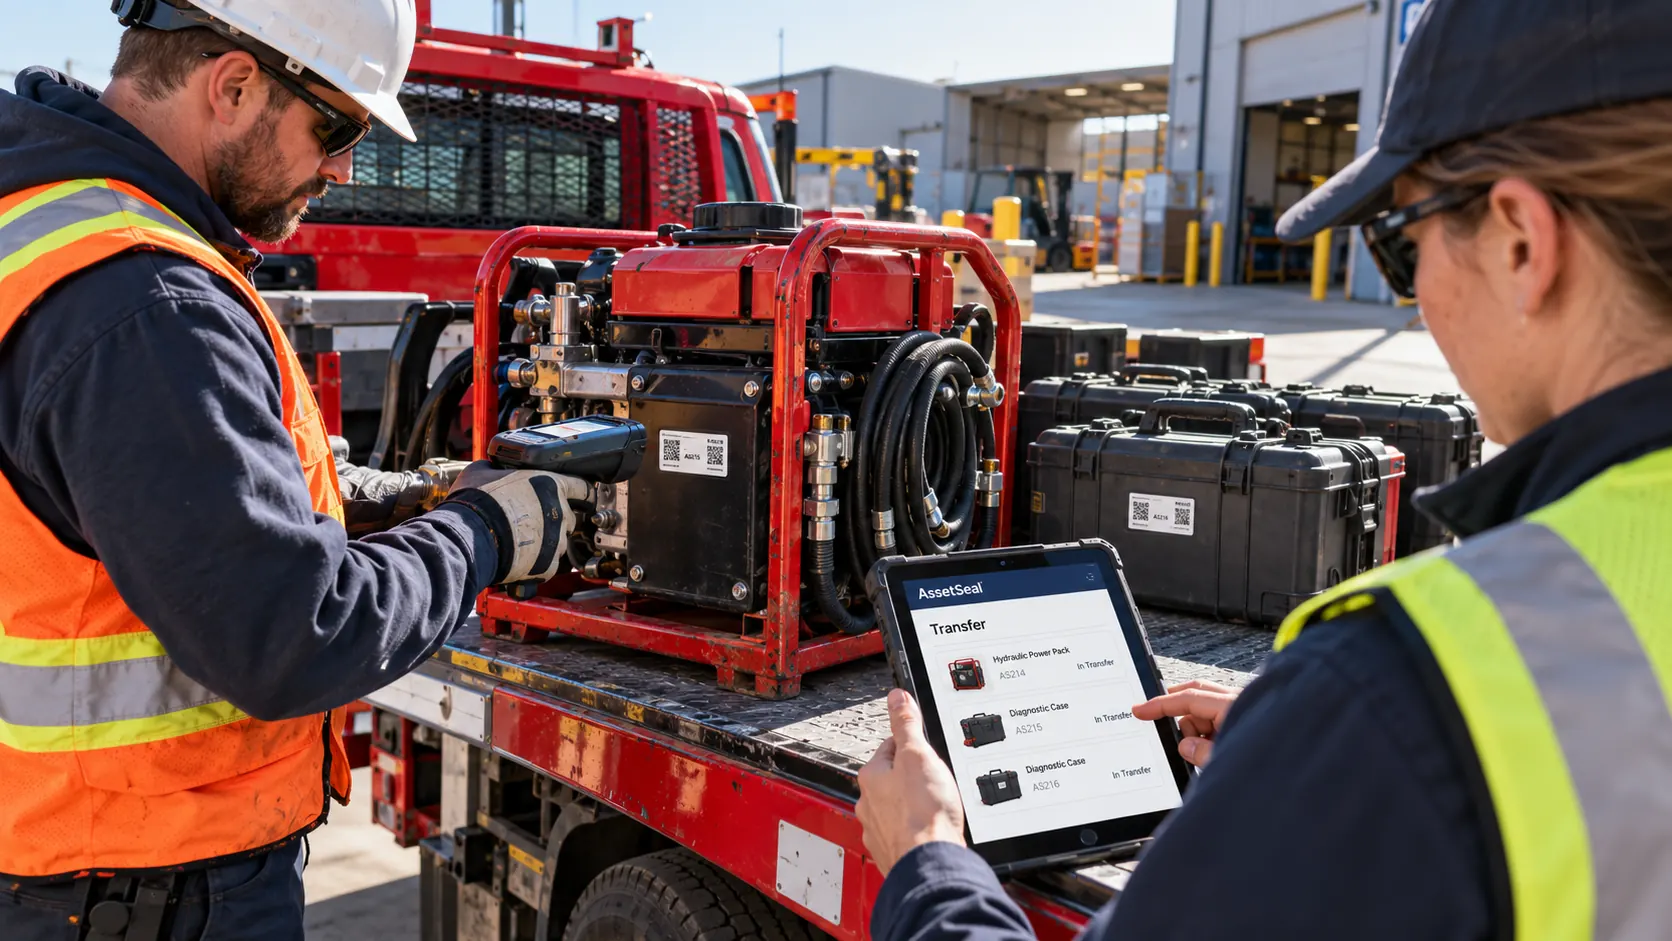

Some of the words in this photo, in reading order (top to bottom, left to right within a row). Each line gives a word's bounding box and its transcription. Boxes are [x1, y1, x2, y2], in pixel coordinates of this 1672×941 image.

[918, 581, 983, 600] AssetSeal
[929, 619, 986, 635] Transfer
[993, 651, 1029, 664] Hydraulic
[1029, 649, 1051, 659] Power
[1052, 646, 1070, 655] Pack
[1085, 658, 1114, 669] Transfer
[1000, 669, 1026, 680] AS214
[1009, 705, 1049, 718] Diagnostic
[1050, 702, 1069, 711] Case
[1094, 716, 1102, 724] In
[1102, 711, 1133, 722] Transfer
[1016, 723, 1043, 735] AS215
[1026, 760, 1066, 774] Diagnostic
[1067, 756, 1086, 766] Case
[1112, 771, 1120, 779] In
[1120, 766, 1151, 778] Transfer
[1032, 779, 1060, 791] AS216
